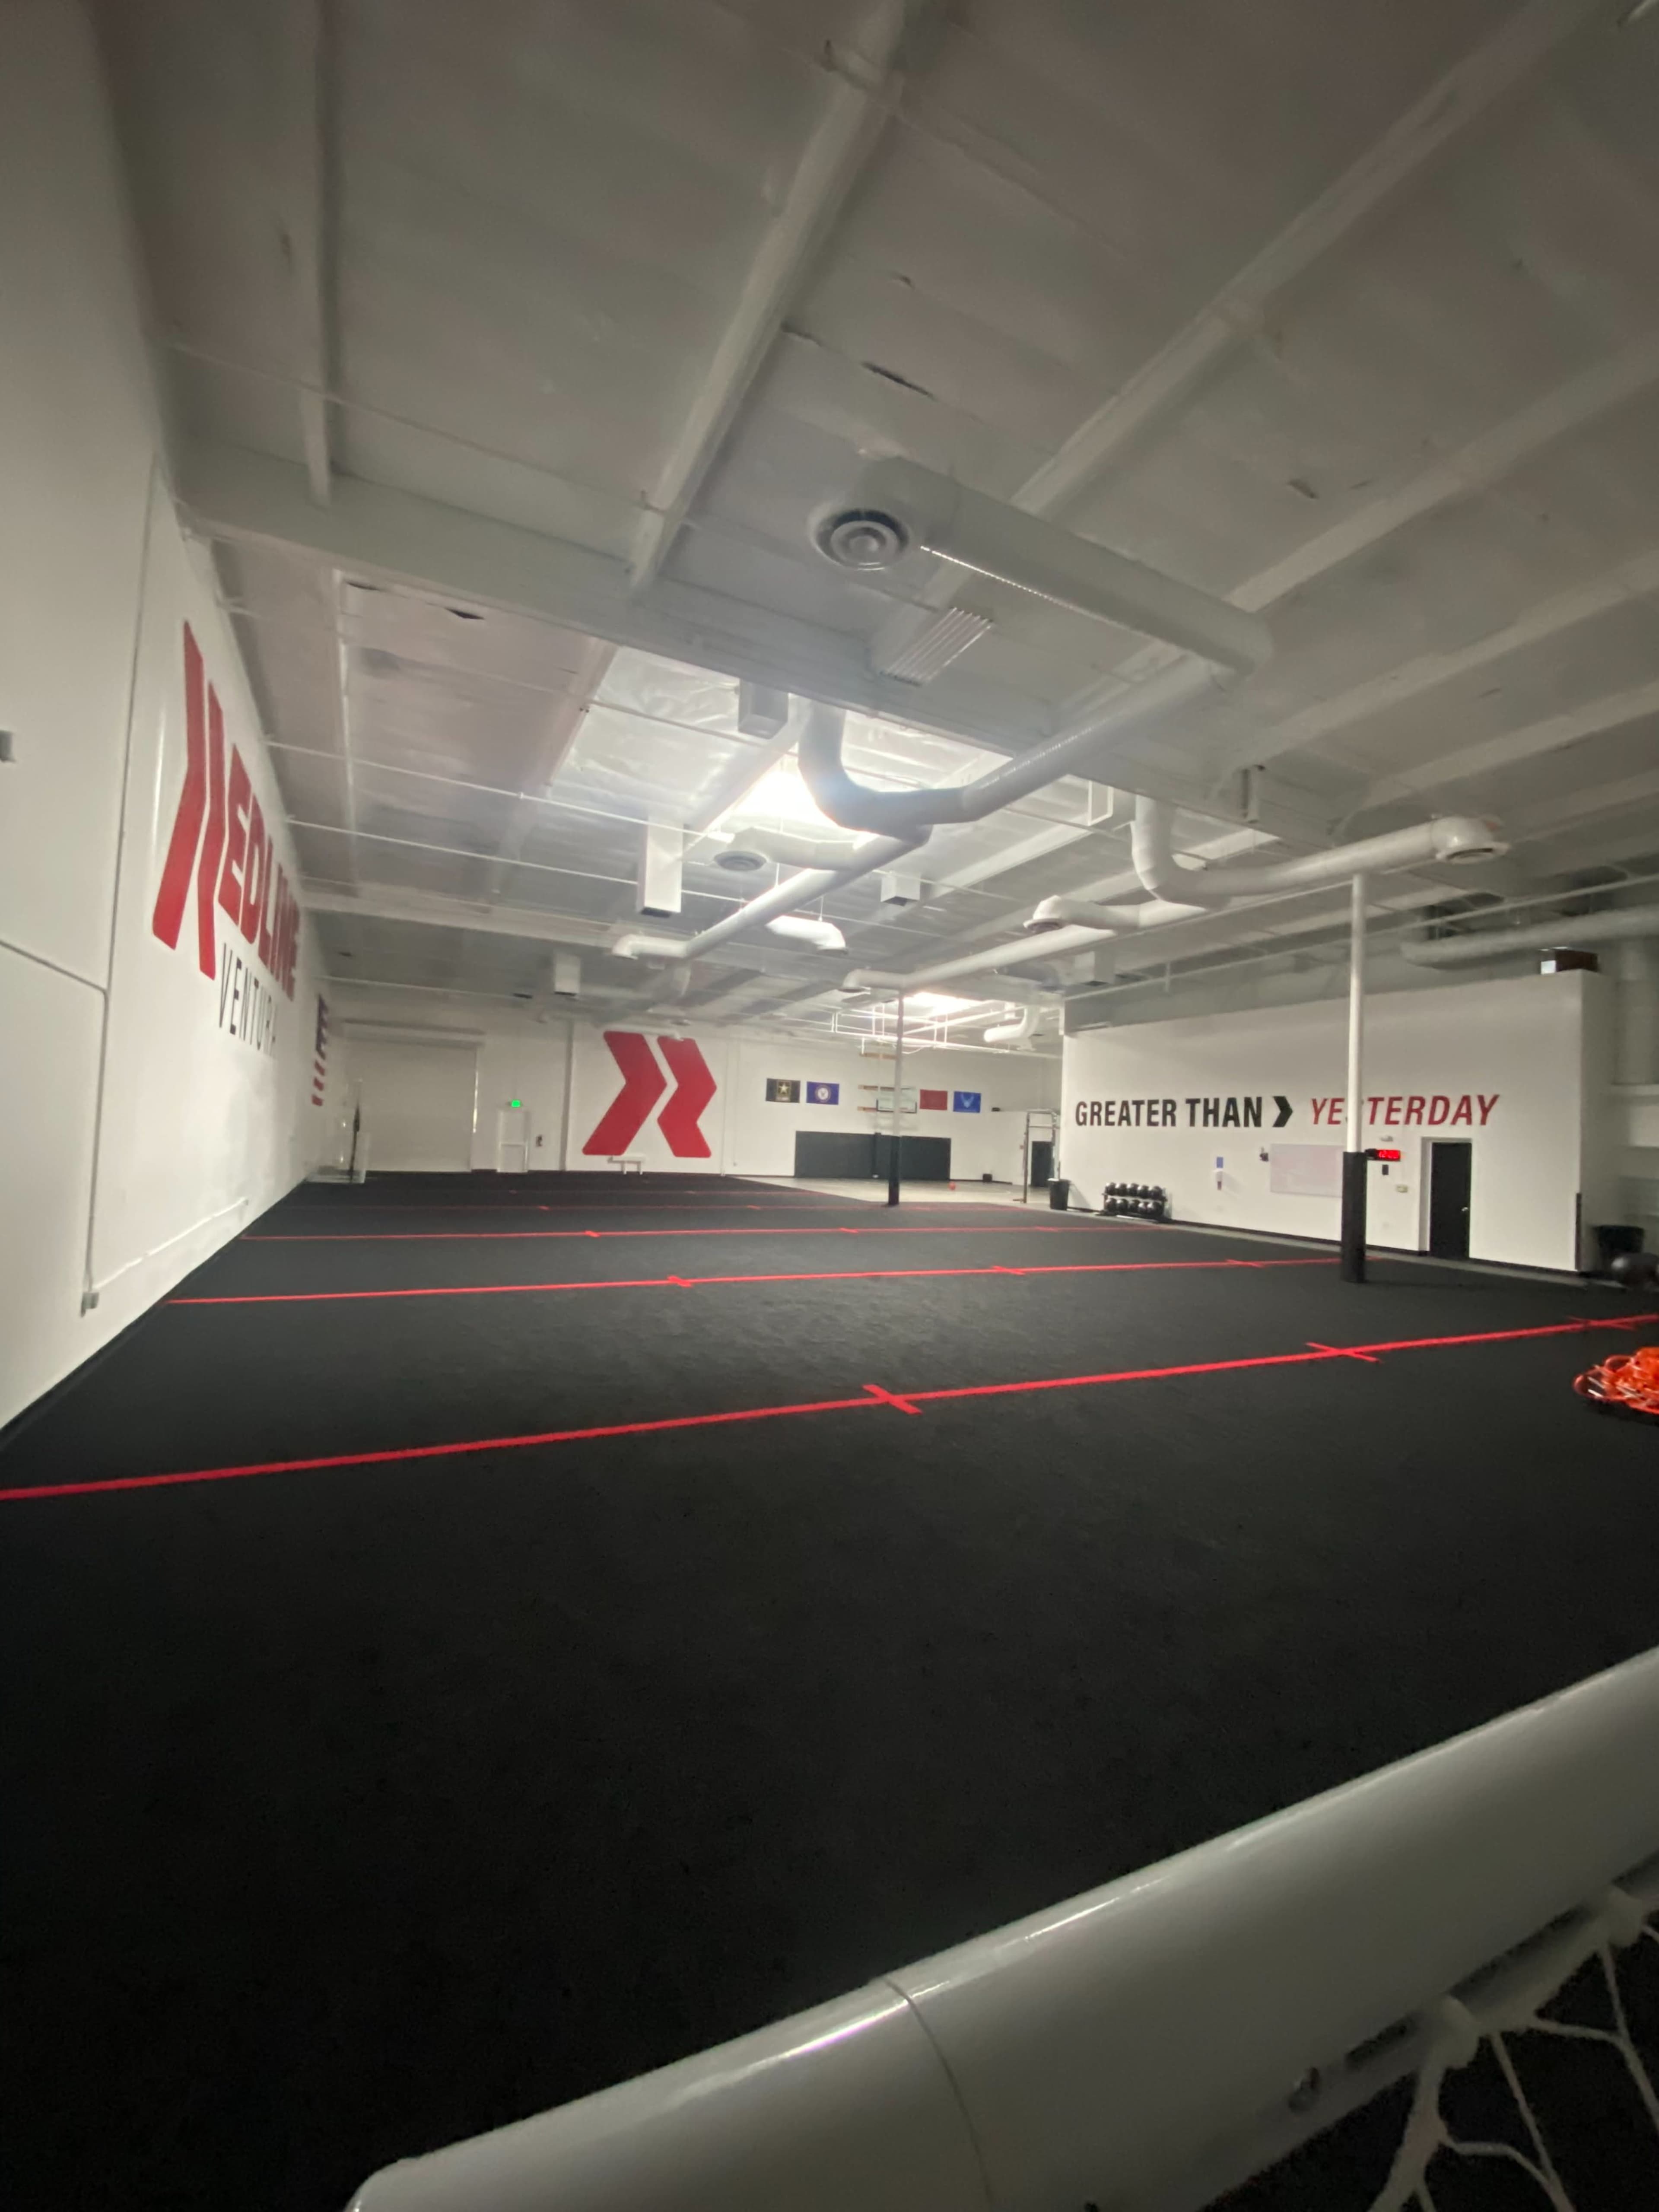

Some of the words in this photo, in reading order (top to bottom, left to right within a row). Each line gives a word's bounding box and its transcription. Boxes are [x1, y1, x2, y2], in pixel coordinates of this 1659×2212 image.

[1075, 1099, 1177, 1127] GREATER
[1185, 1096, 1262, 1128] THAN
[1311, 1094, 1500, 1126] YETERDAY
